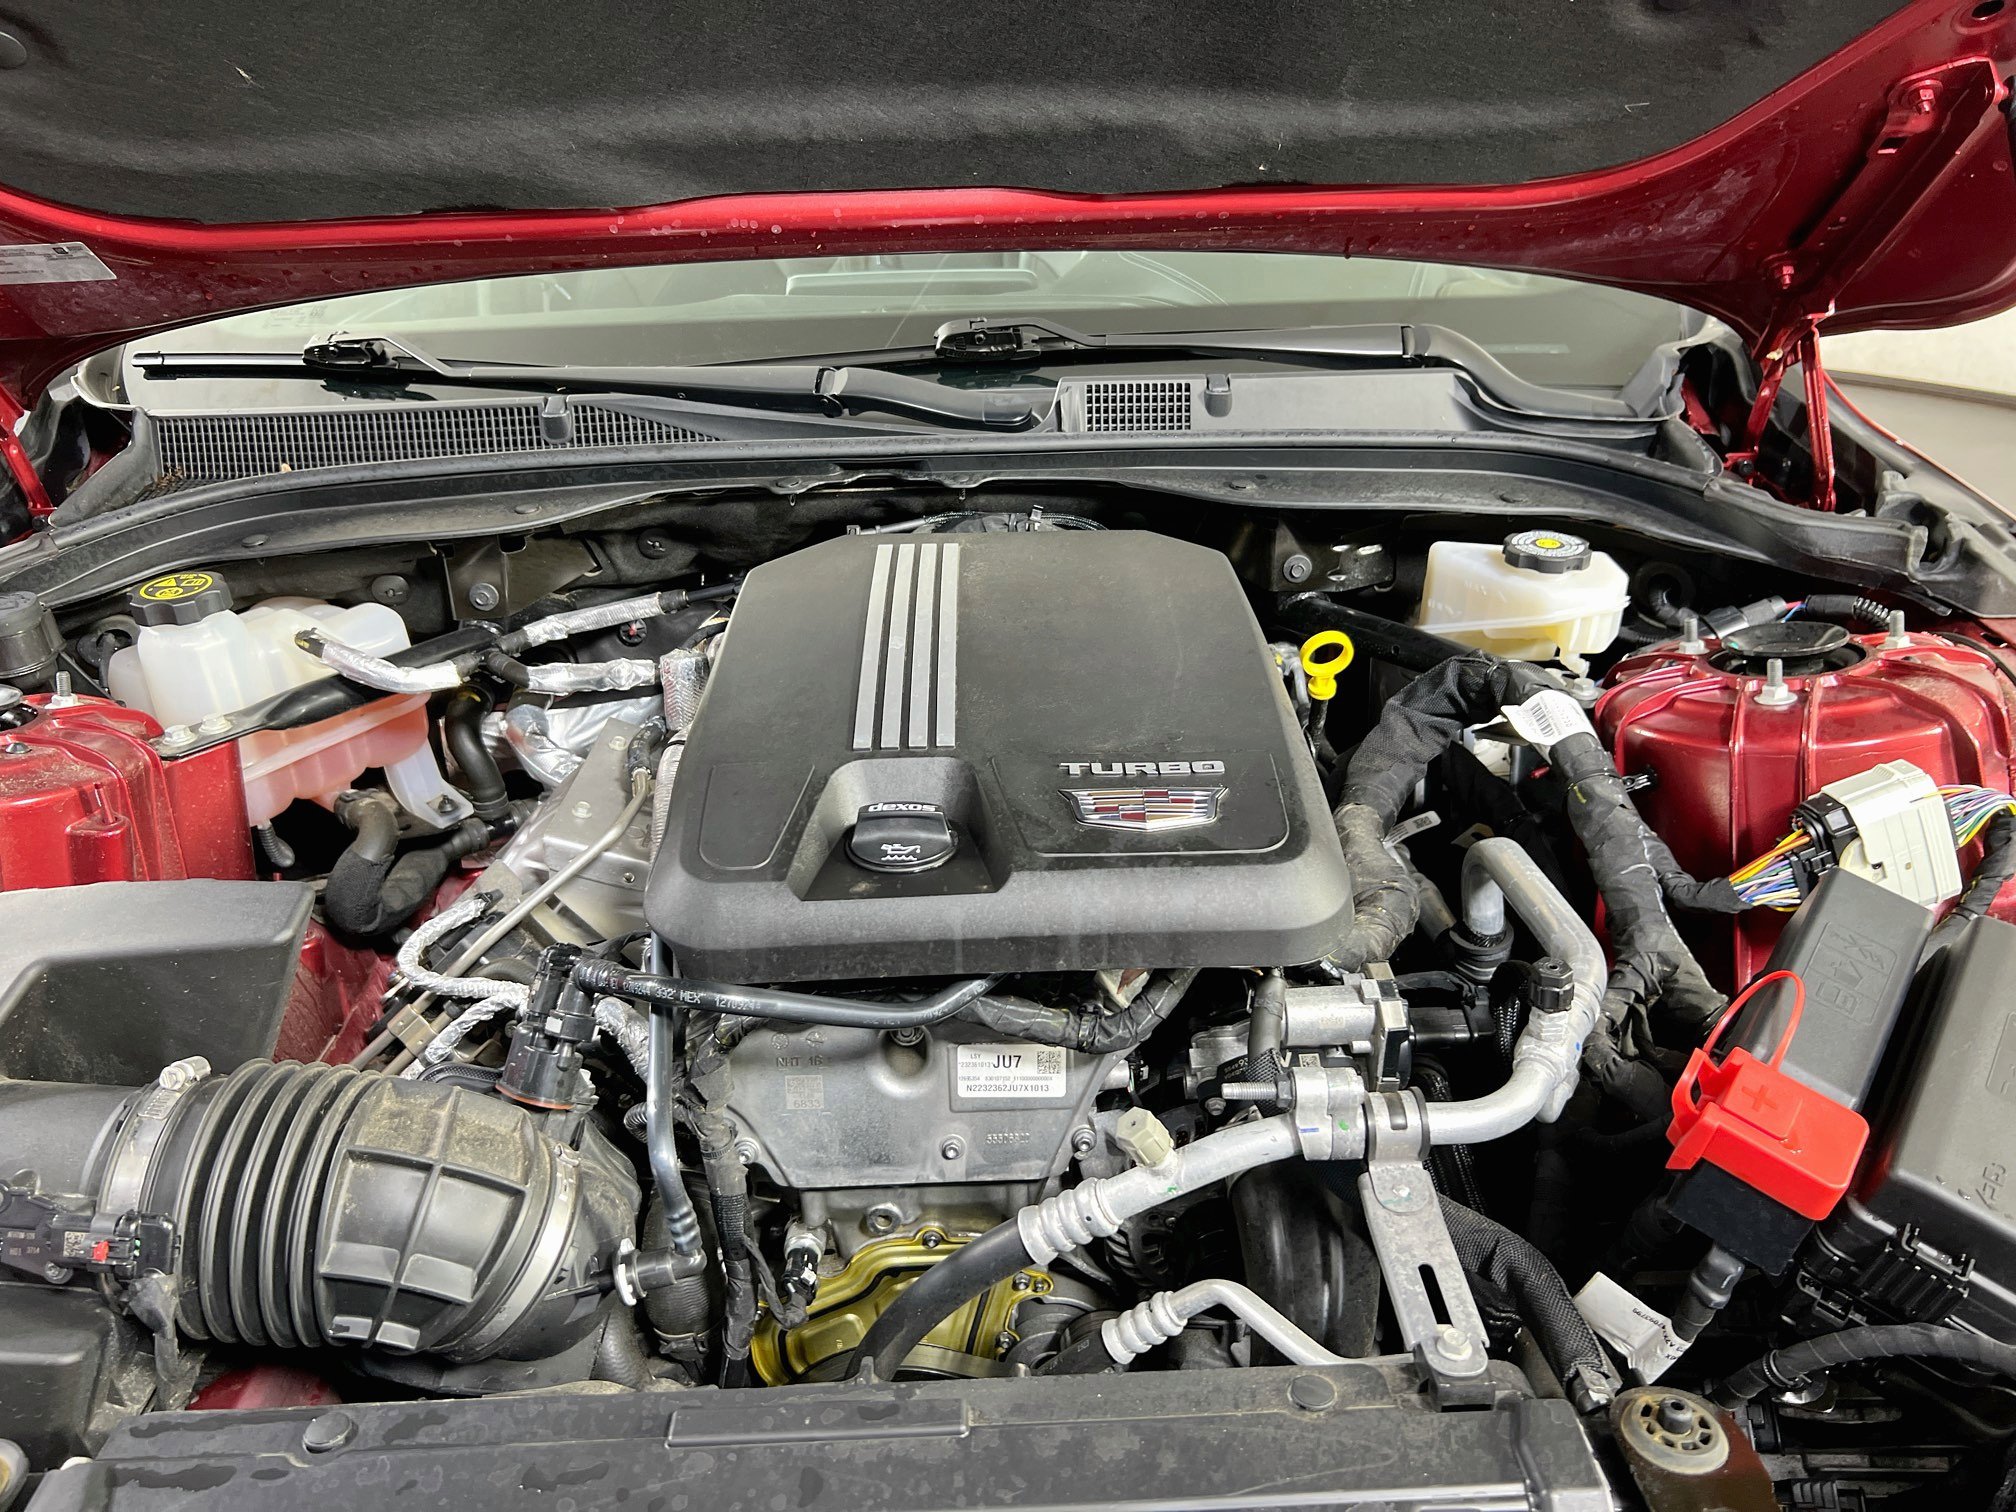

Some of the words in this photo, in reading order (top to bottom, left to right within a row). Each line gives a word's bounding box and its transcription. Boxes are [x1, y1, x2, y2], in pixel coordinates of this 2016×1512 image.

[1059, 760, 1226, 776] TURBO
[868, 802, 939, 812] dexos
[680, 989, 702, 1004] MEX
[992, 1054, 1022, 1069] JU7
